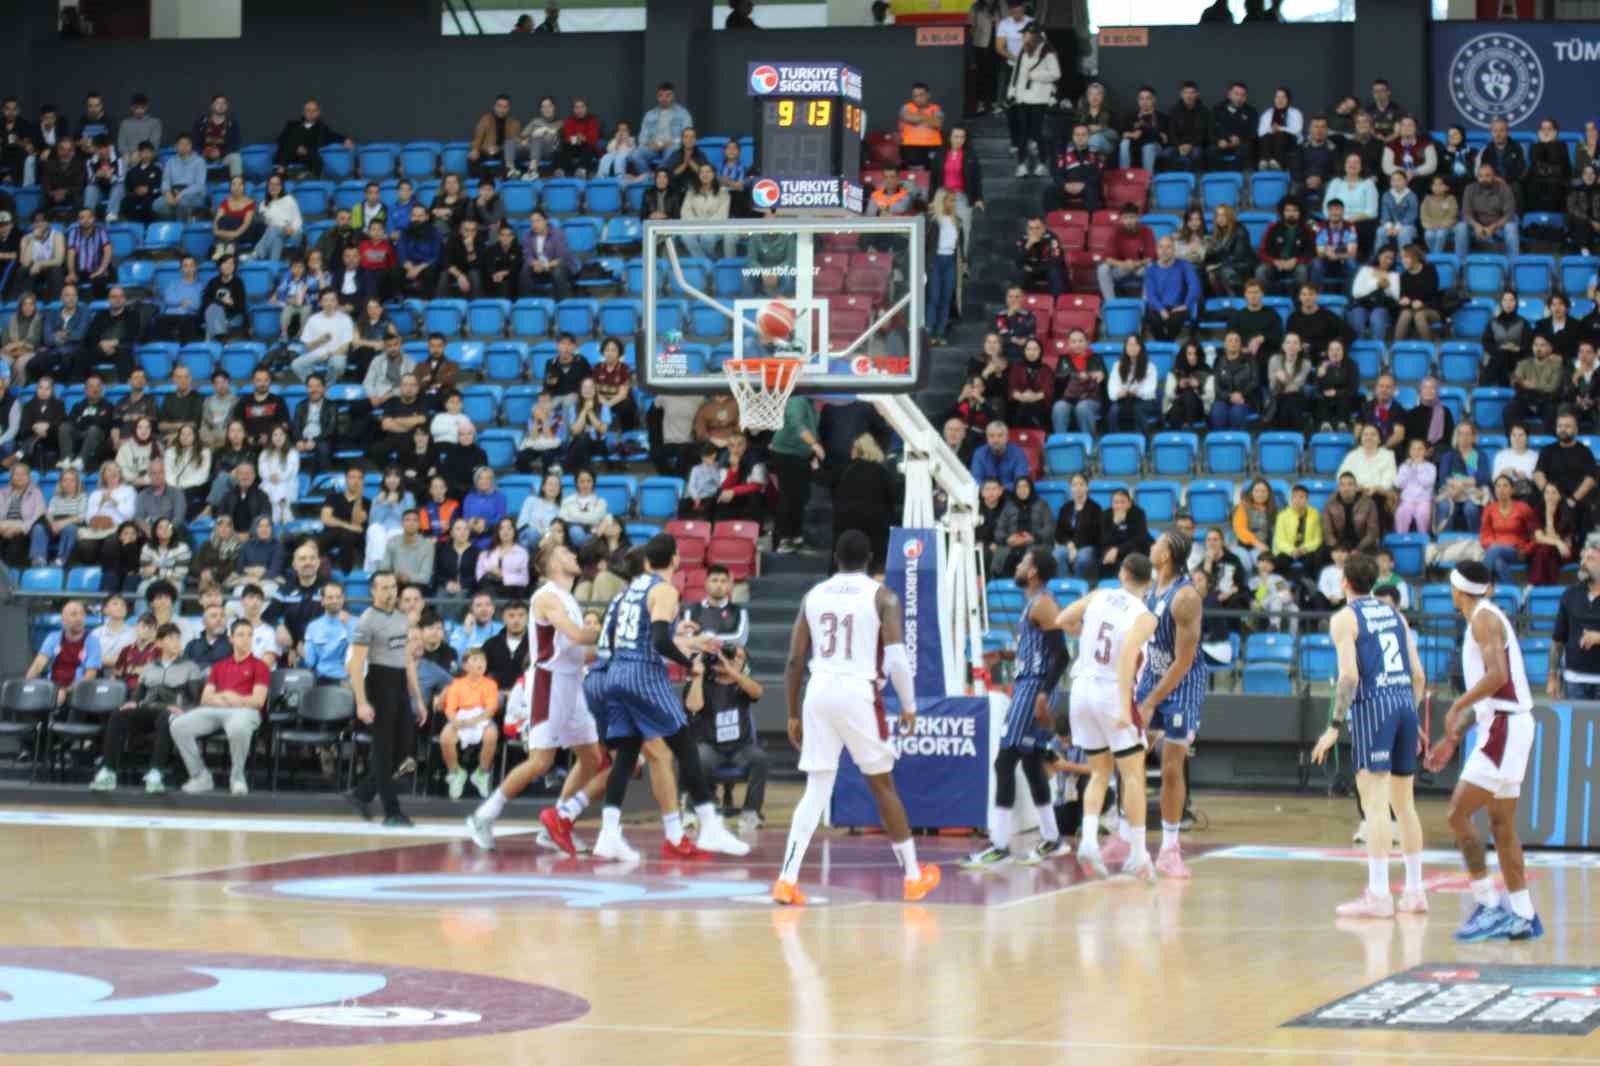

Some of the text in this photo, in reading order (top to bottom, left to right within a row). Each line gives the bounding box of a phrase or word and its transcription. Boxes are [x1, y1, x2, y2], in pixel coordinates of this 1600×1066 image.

[778, 101, 794, 126] 9
[808, 101, 830, 126] 13
[820, 612, 854, 660] 31
[1095, 621, 1114, 665] 5
[1379, 633, 1404, 672] 2
